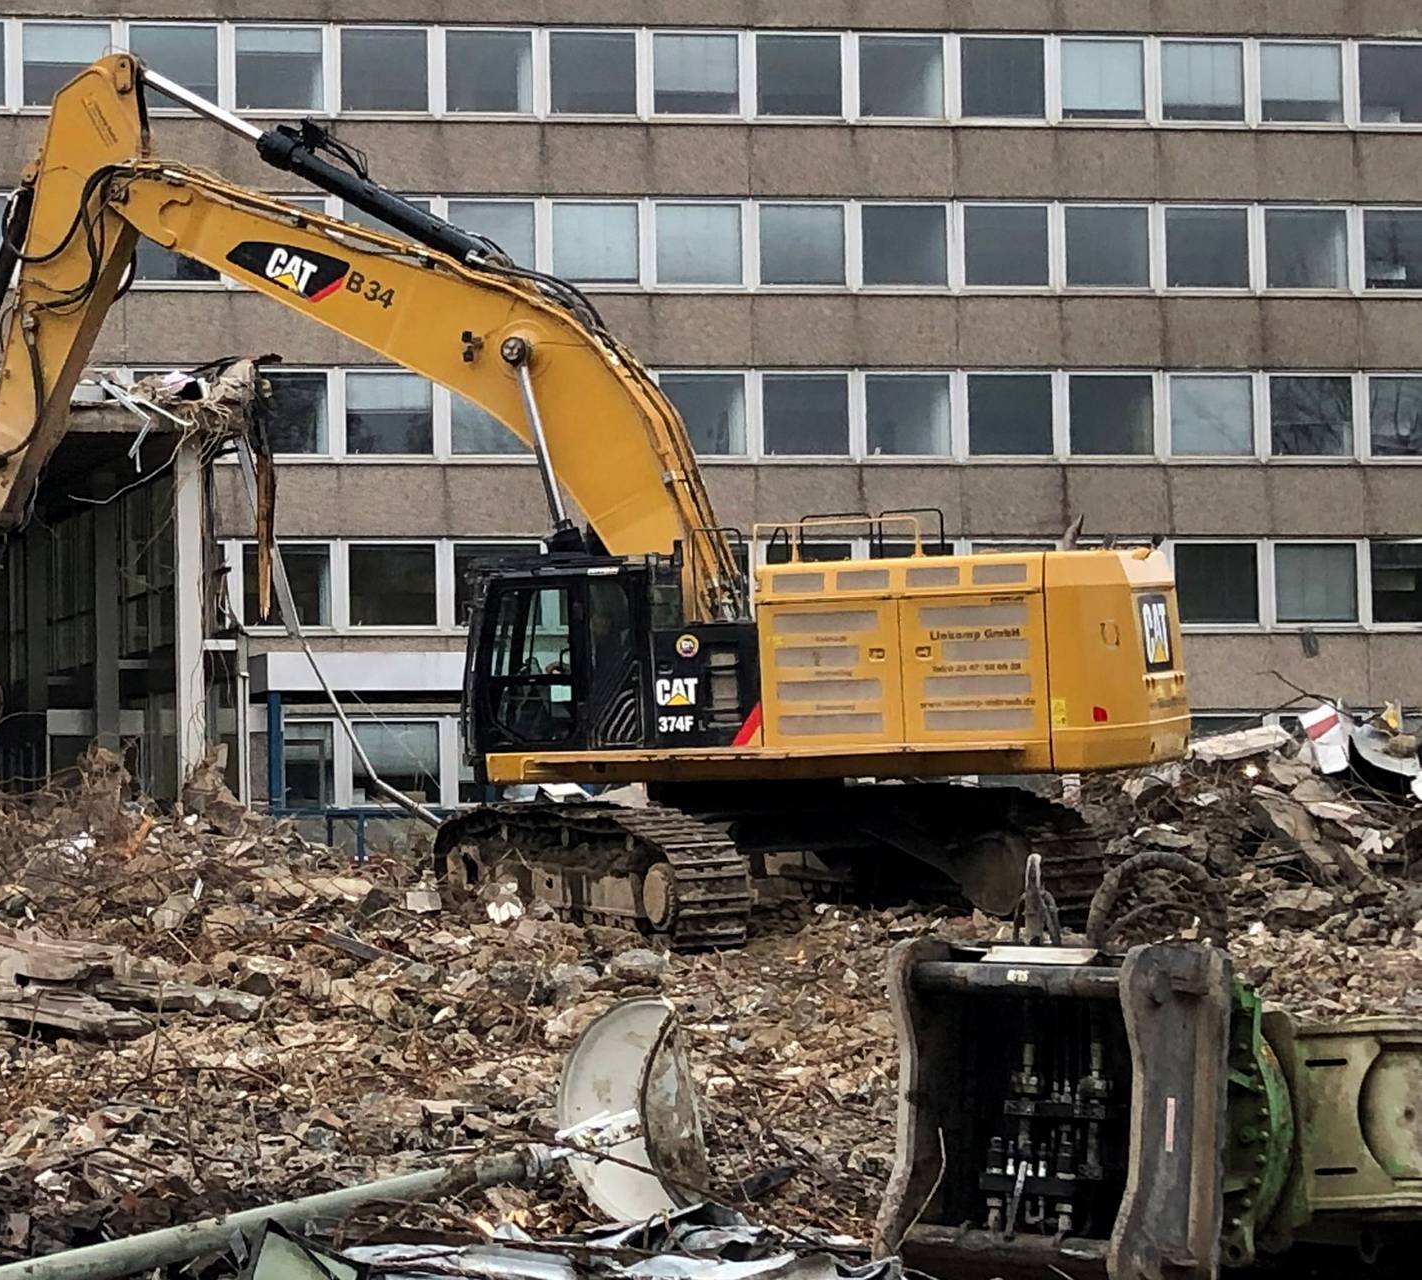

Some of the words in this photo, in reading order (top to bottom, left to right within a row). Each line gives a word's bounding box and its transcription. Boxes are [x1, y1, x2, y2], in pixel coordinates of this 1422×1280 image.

[265, 248, 318, 293] CAT
[984, 628, 1020, 638] GmbH
[1142, 603, 1170, 664] CAT
[656, 678, 698, 706] CAT
[658, 715, 694, 733] 374F
